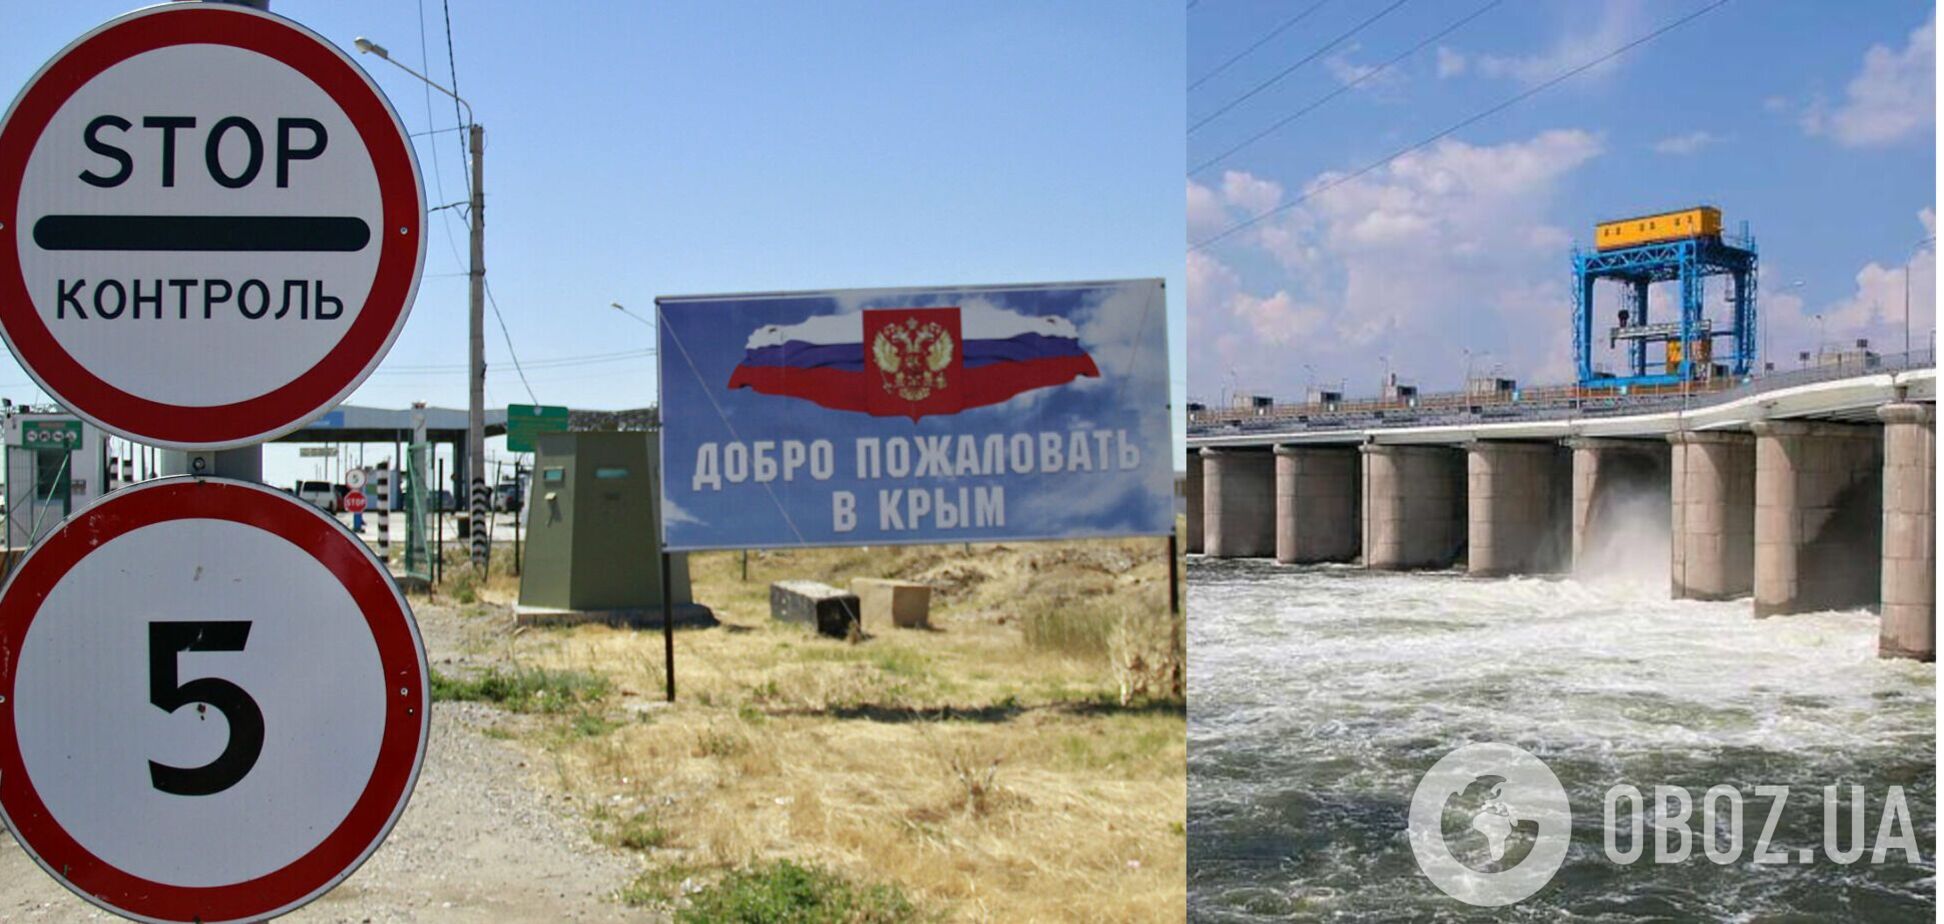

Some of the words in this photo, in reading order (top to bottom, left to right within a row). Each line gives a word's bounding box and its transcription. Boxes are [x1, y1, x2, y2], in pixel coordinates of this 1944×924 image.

[78, 115, 328, 189] STOP
[57, 279, 344, 320] КОНТРОЛЬ
[692, 439, 835, 491] ДОБРО
[856, 429, 1141, 478] ПОЖАЛОВАТЬ
[346, 499, 366, 508] STOP
[832, 491, 856, 532] В
[879, 486, 1006, 530] КРЫМ
[148, 620, 265, 796] 5
